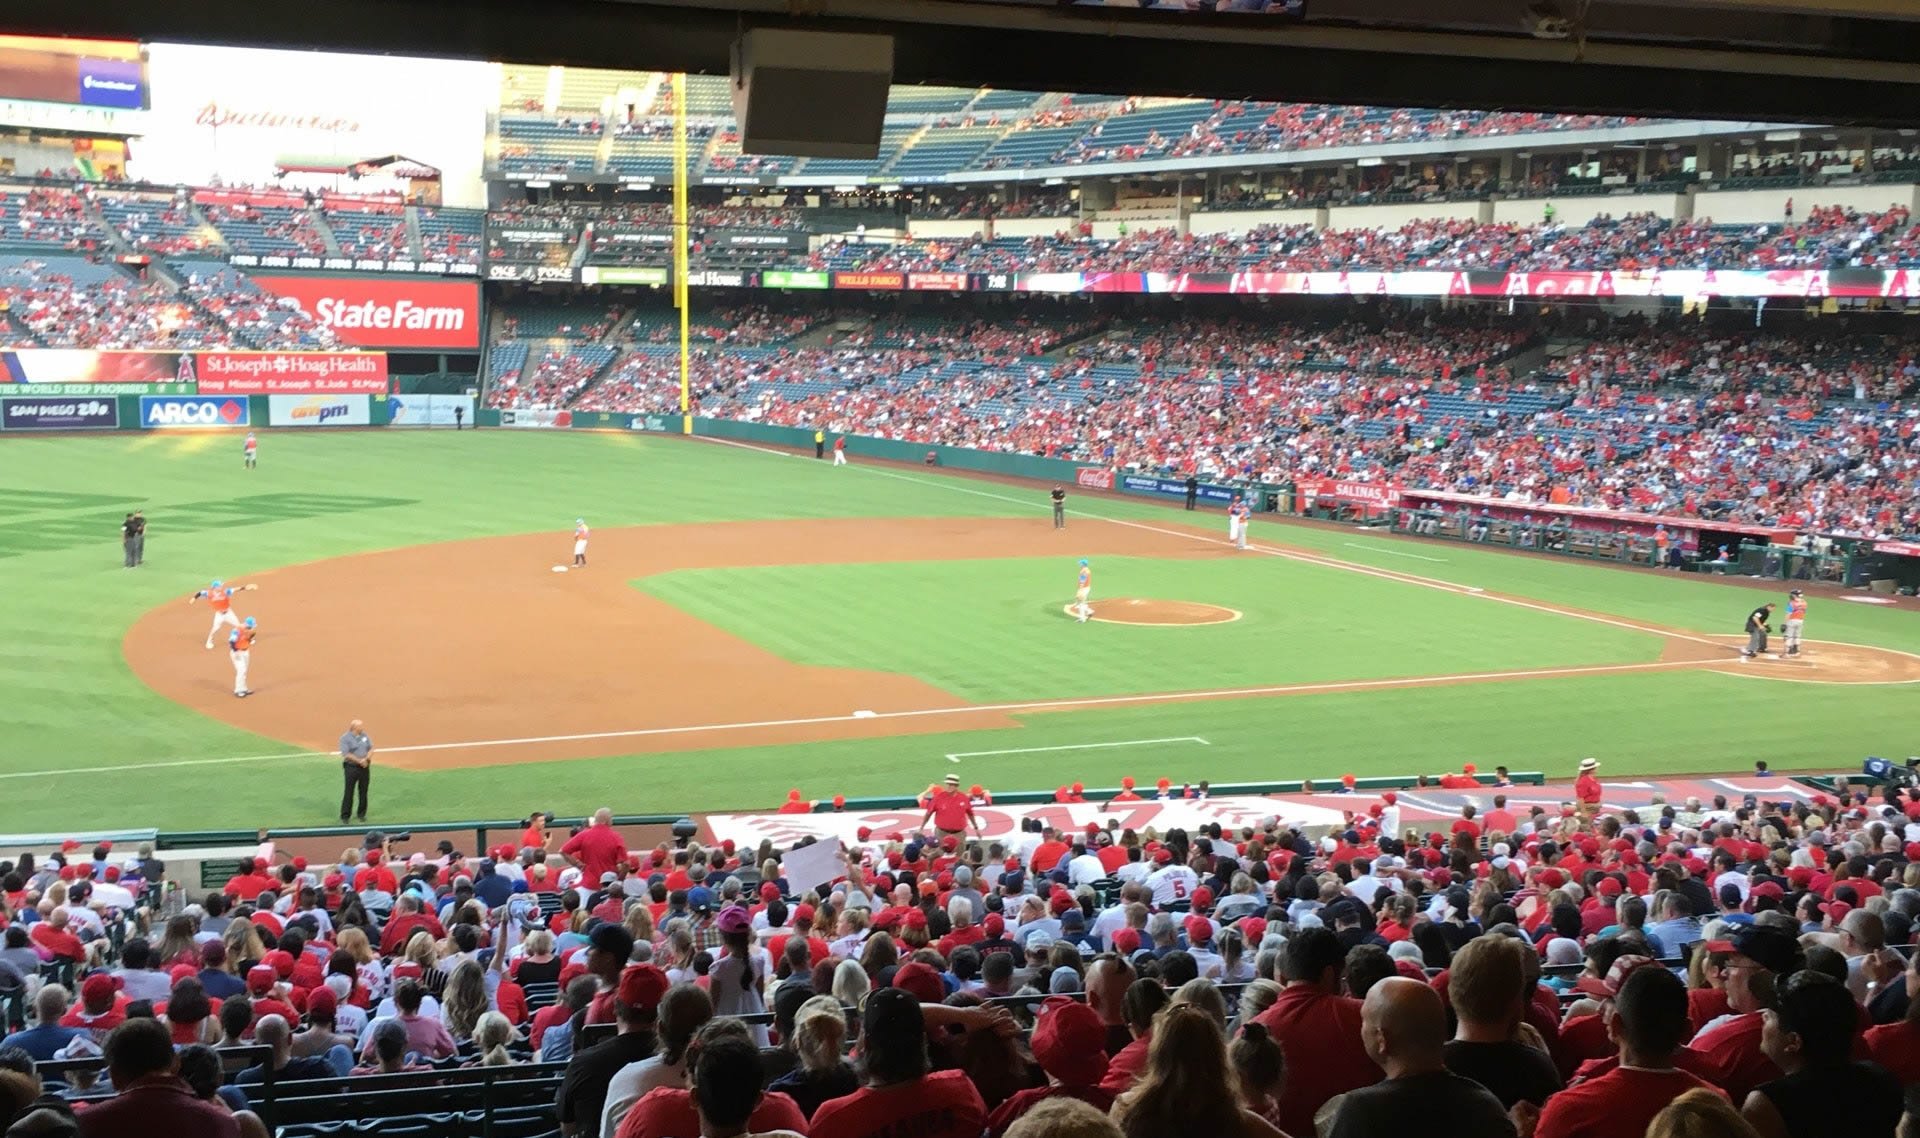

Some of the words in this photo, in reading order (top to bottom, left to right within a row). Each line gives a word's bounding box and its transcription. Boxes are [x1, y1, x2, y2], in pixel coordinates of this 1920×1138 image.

[706, 272, 742, 286] House
[838, 275, 869, 286] WELLS
[870, 275, 900, 286] FARGO
[290, 357, 328, 377] Hoag
[329, 358, 376, 373] Health
[22, 383, 61, 394] WORLD
[64, 383, 91, 395] KEEP
[94, 383, 148, 394] PROMISES
[228, 380, 262, 389] Mission
[9, 405, 38, 417] SAN
[39, 403, 76, 417] DIEGO
[148, 402, 218, 423] ARCO
[1388, 489, 1400, 501] IN
[1173, 879, 1186, 898] 5
